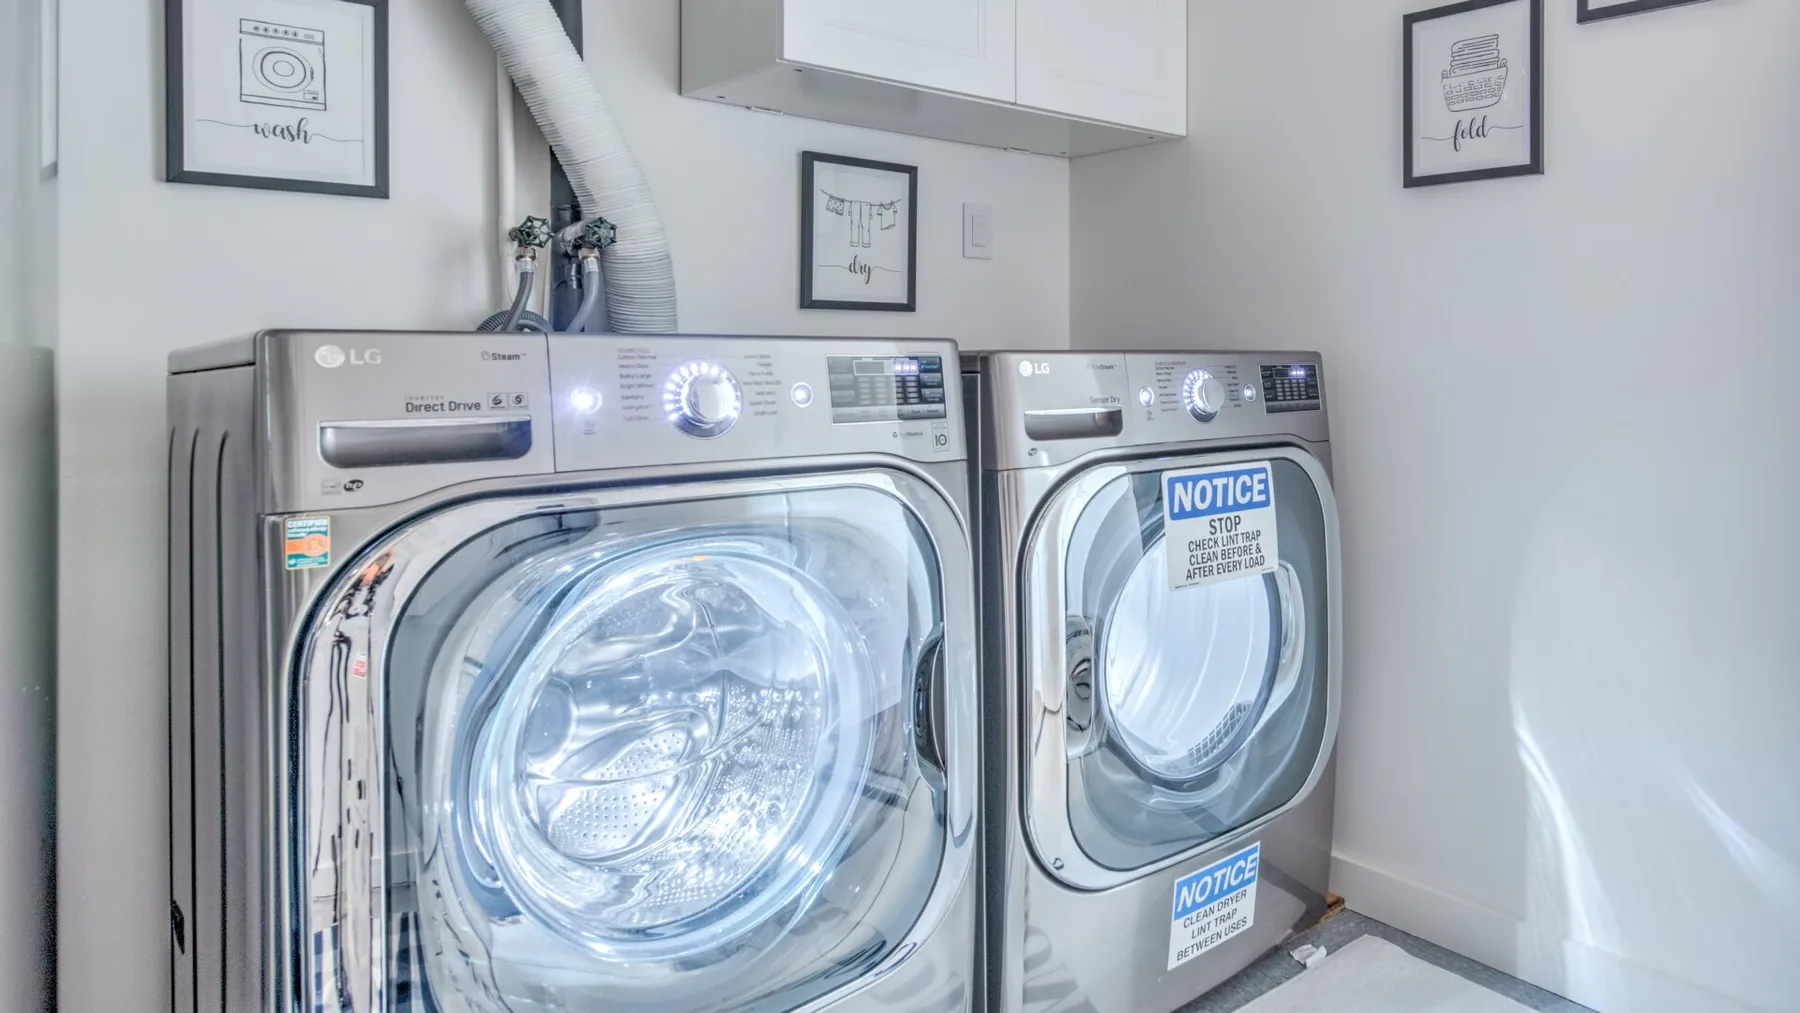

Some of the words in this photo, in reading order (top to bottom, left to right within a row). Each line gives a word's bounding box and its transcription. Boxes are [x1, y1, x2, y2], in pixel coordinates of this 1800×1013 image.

[253, 117, 310, 144] wash
[1454, 115, 1488, 152] fold
[848, 254, 872, 285] dry
[350, 348, 382, 365] LG
[1034, 362, 1050, 374] LG
[405, 402, 445, 413] Direct
[448, 400, 481, 412] Drive
[1089, 397, 1109, 405] Sensor
[1110, 396, 1120, 404] Dry
[1173, 472, 1266, 514] NOTICE
[1209, 515, 1241, 535] STOP
[1188, 537, 1220, 552] CHECK
[1221, 534, 1239, 547] LINT
[1241, 530, 1261, 543] TRAP
[1189, 551, 1219, 566] CLEAN
[1221, 544, 1254, 561] BEFORE
[1255, 543, 1262, 554] &
[1186, 565, 1214, 581] AFTER
[1216, 559, 1242, 575] EVERY
[1244, 555, 1265, 569] LOAD
[1177, 853, 1258, 912] NOTICE
[1183, 905, 1215, 928] CLEAN
[1217, 889, 1246, 912] DRYER
[1191, 922, 1212, 939] LINT
[1214, 908, 1237, 927] TRAP
[1177, 932, 1222, 961] BETWEEN
[1224, 916, 1247, 936] USES
